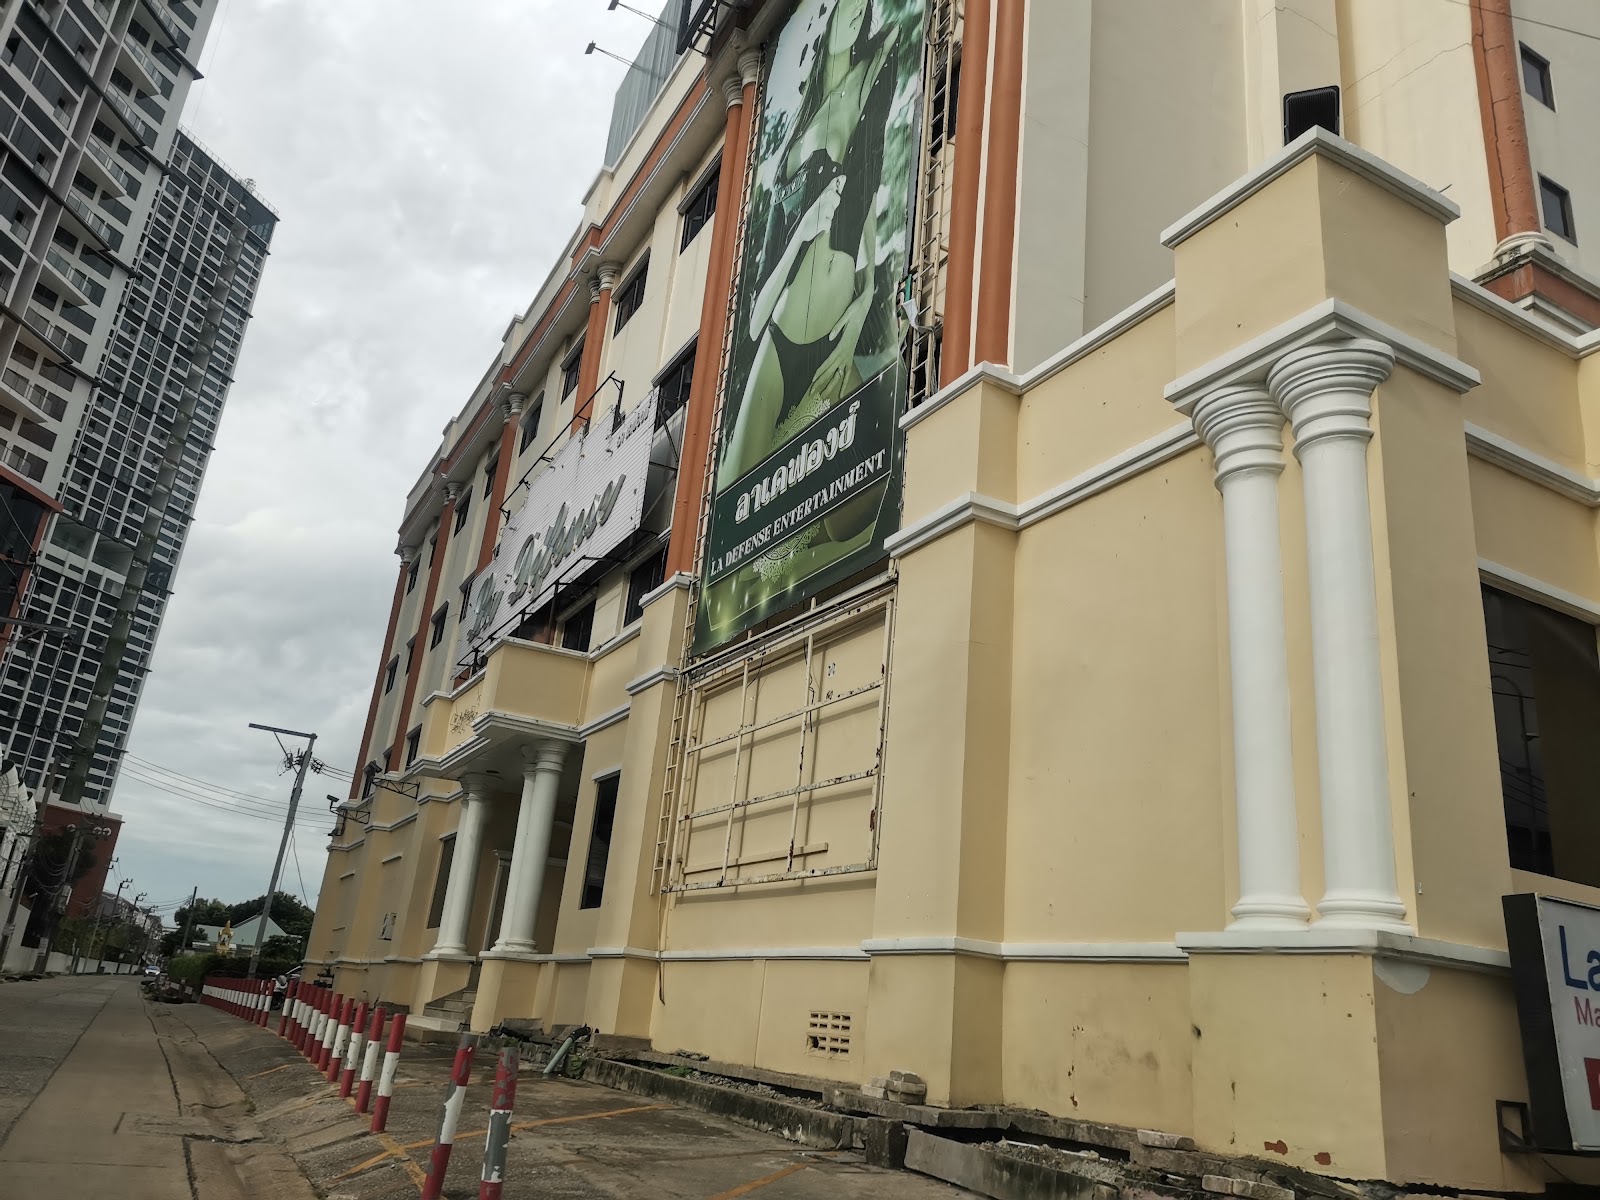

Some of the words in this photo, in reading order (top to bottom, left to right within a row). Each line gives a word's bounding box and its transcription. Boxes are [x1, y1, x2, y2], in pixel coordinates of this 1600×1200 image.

[710, 558, 724, 577] LA
[725, 523, 773, 567] DEFENSE
[773, 448, 887, 536] ENTERTAINMENT
